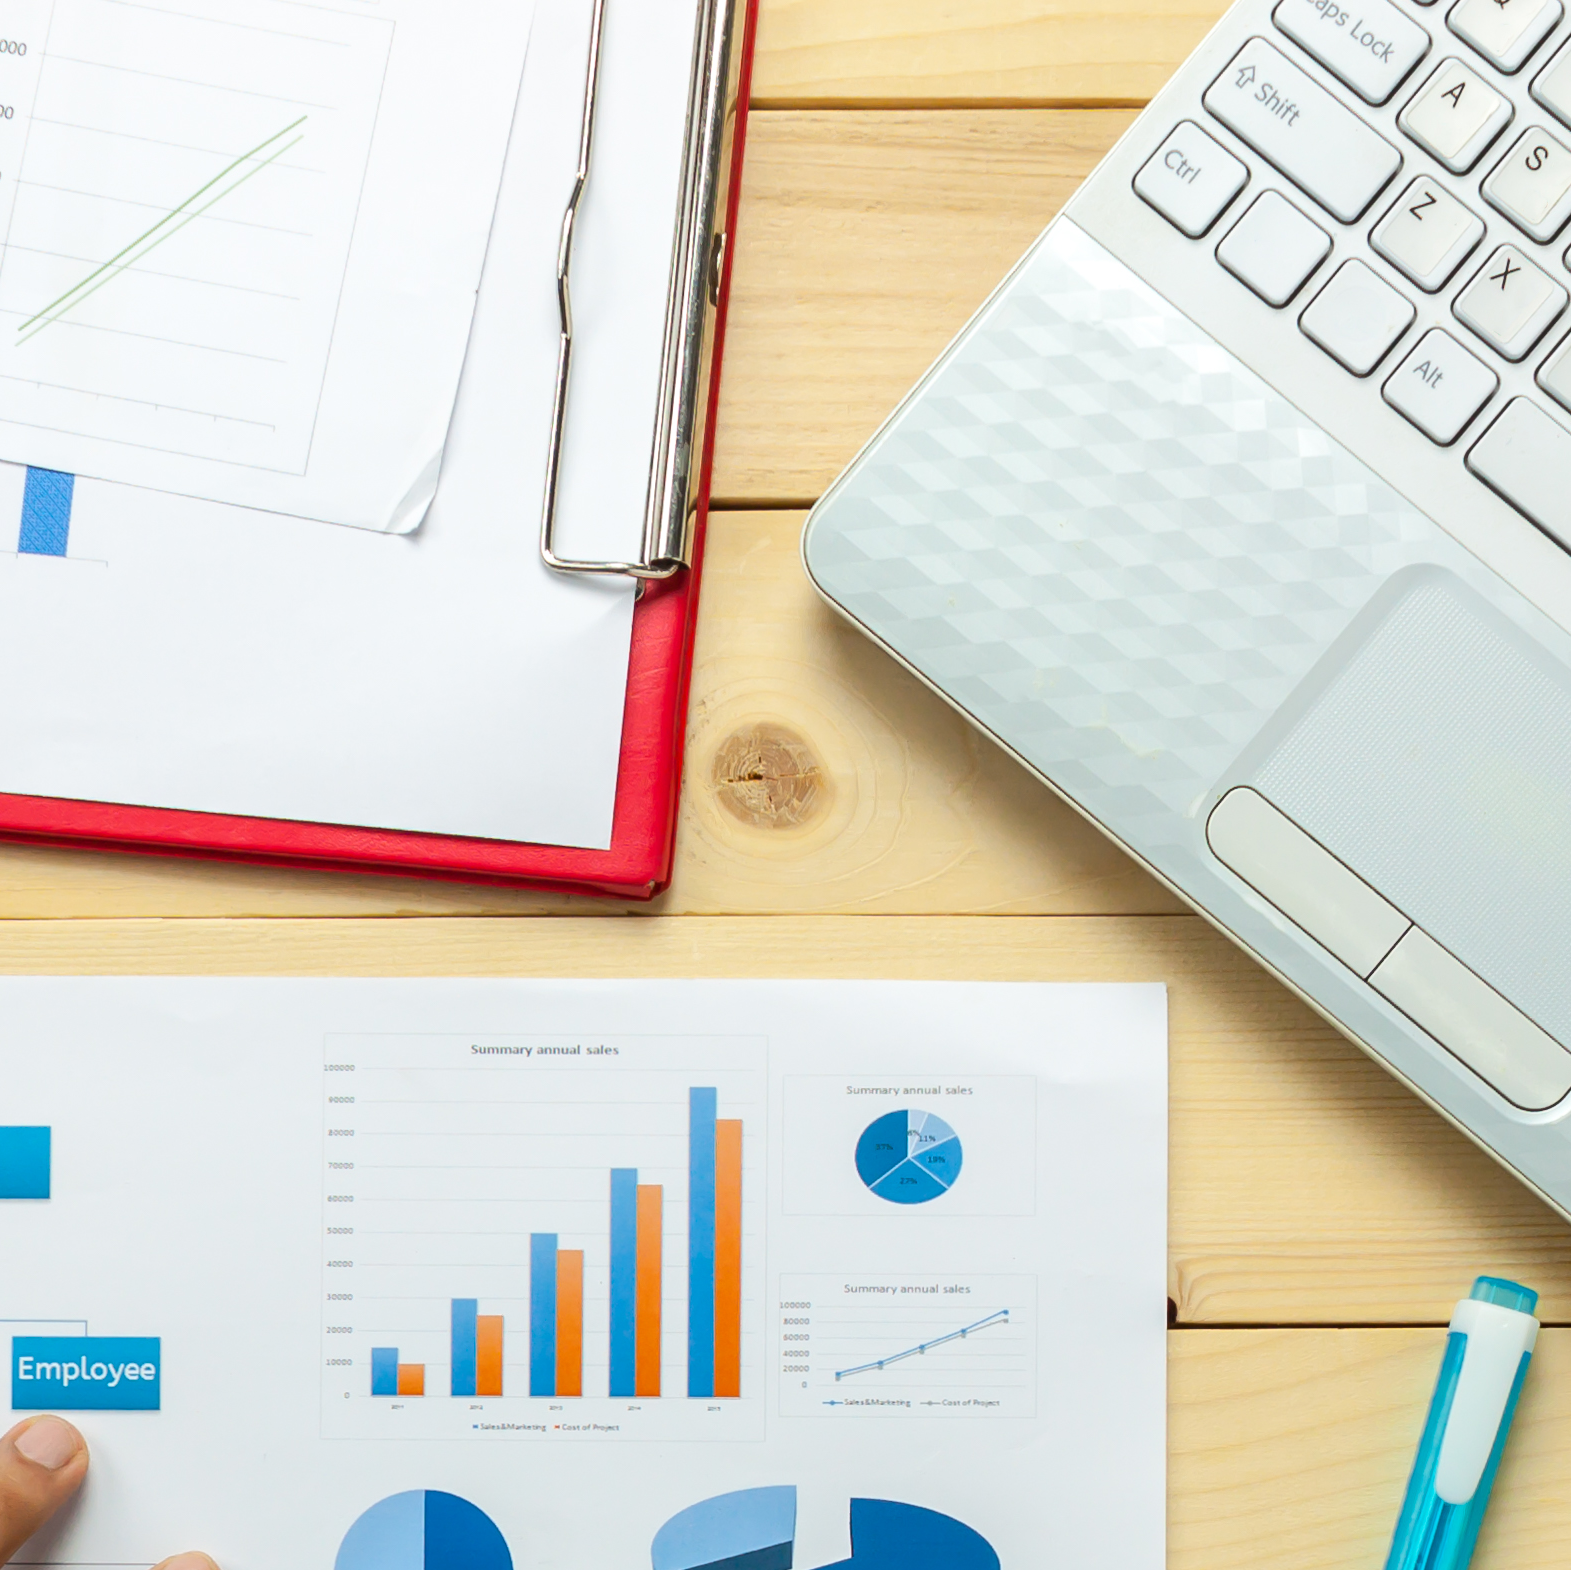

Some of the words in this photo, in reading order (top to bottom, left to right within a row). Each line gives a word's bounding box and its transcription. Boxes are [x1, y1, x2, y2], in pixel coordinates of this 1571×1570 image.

[1306, 0, 1350, 26] aps
[1349, 19, 1395, 64] Lock
[1253, 82, 1300, 127] Shift
[1440, 81, 1466, 109] A
[1164, 149, 1202, 185] Ctrl
[1524, 145, 1549, 172] S
[1408, 191, 1437, 221] Z
[1490, 258, 1521, 291] X
[1412, 360, 1443, 389] Alt
[470, 1044, 533, 1058] Summary
[536, 1044, 581, 1055] annual
[586, 1044, 620, 1055] sales
[846, 1086, 899, 1095] Summary
[903, 1086, 941, 1095] annual
[945, 1086, 973, 1095] sales
[327, 1161, 355, 1170] 70000
[844, 1285, 897, 1295] Summary
[901, 1285, 938, 1293] annual
[943, 1285, 970, 1294] sales
[18, 1355, 156, 1385] Employee
